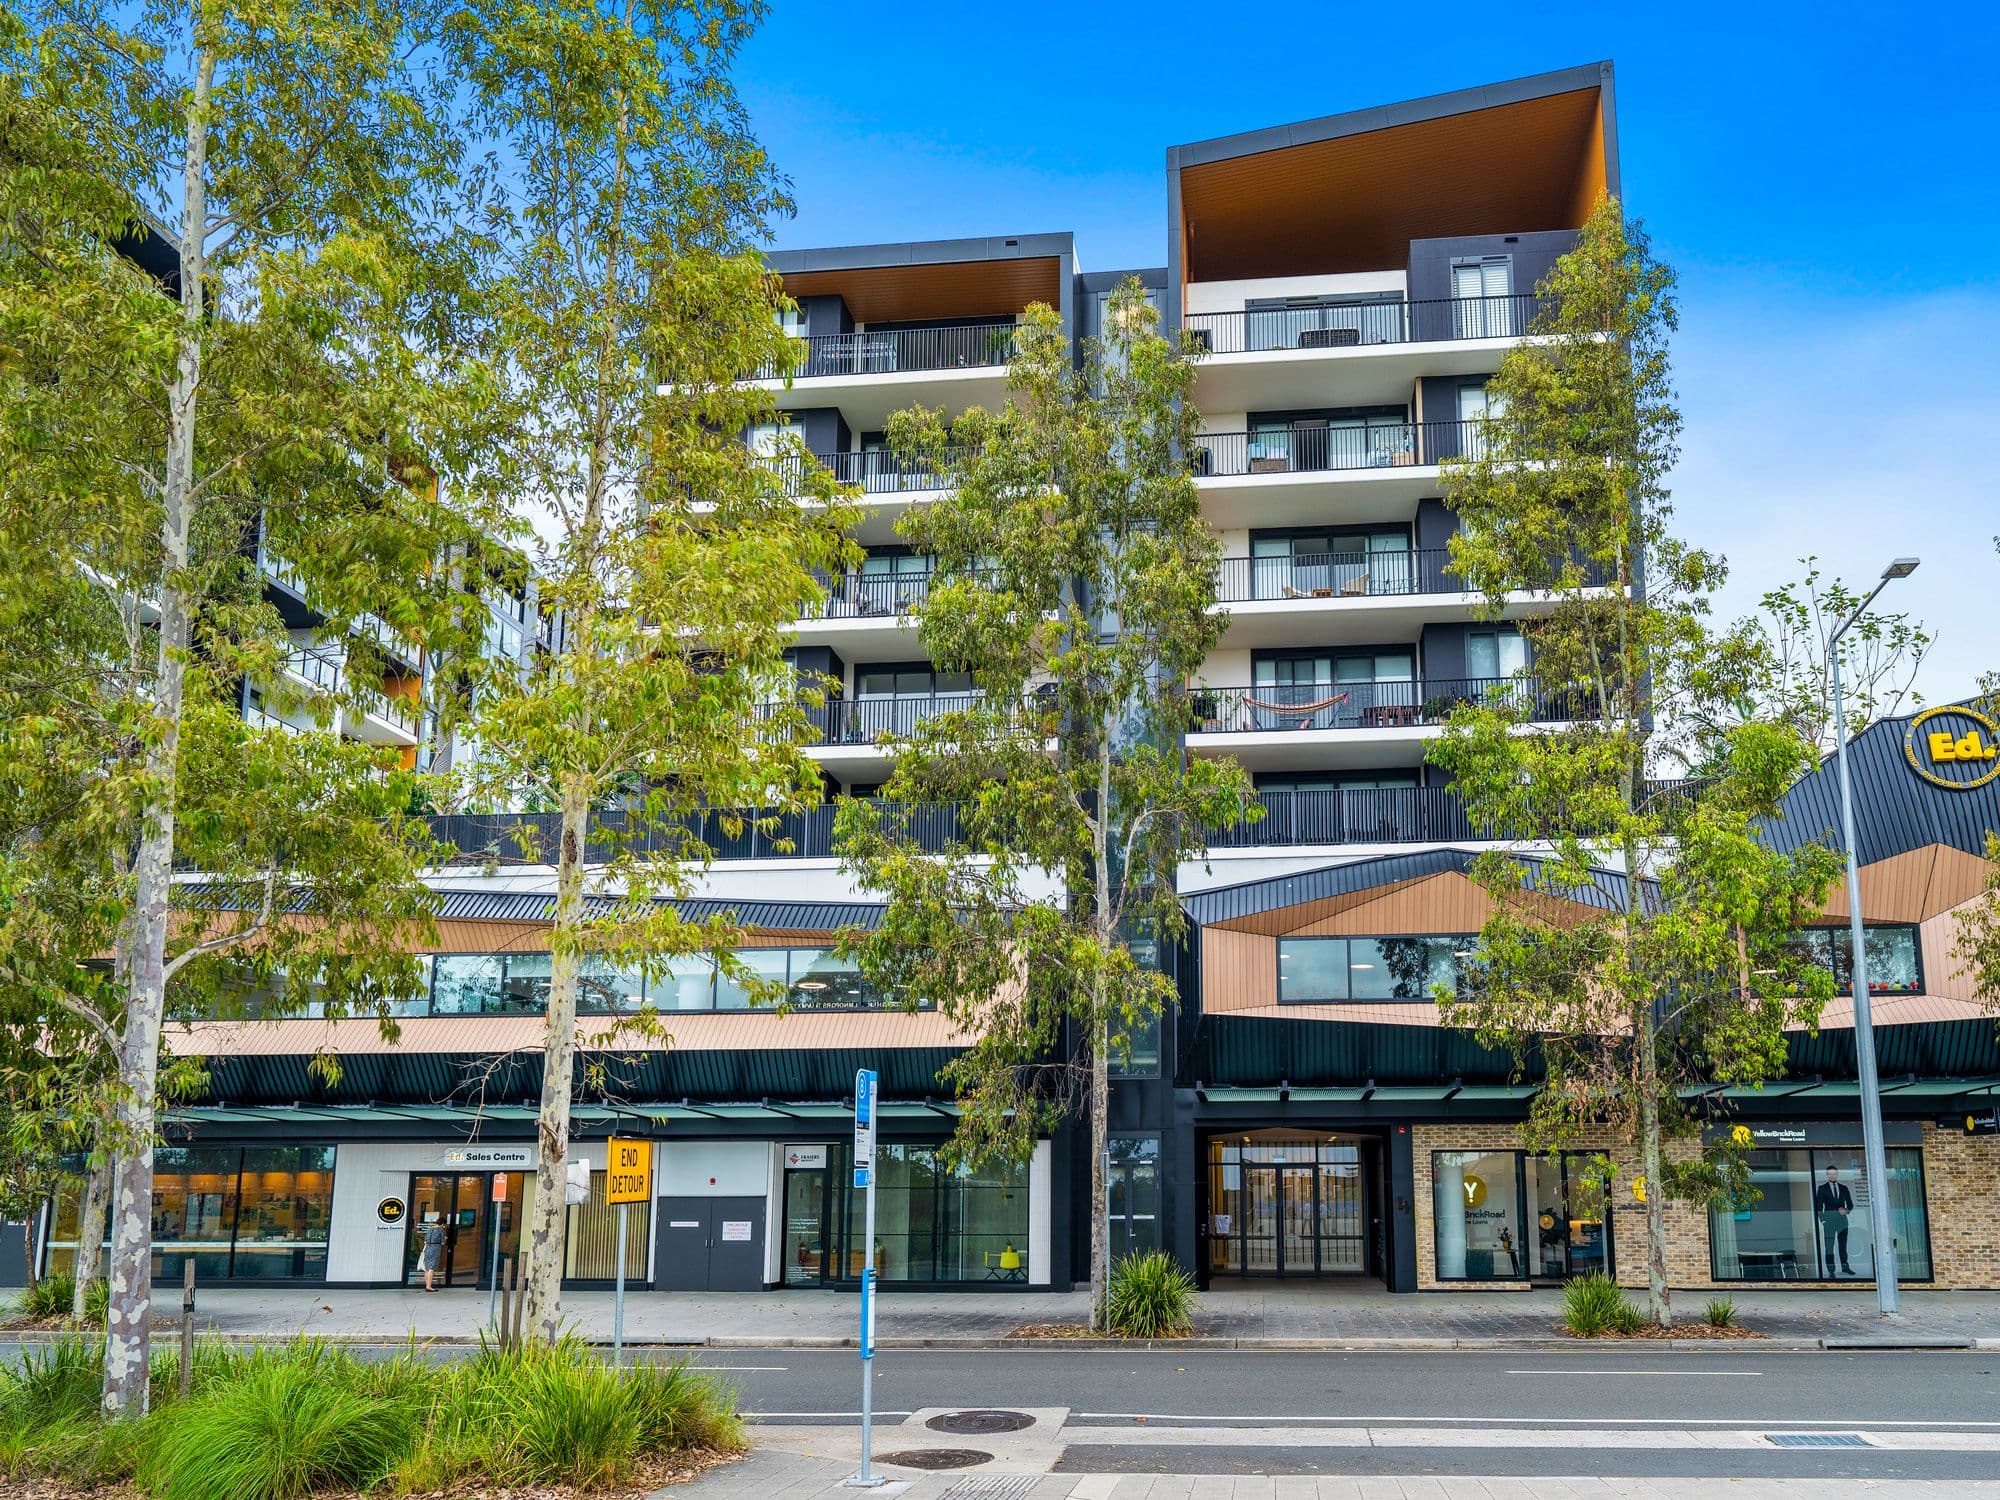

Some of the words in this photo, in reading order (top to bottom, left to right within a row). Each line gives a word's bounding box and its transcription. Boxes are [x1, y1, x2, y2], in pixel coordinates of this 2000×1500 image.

[1949, 706, 1972, 715] TOWN
[1929, 731, 1996, 762] Ed.
[1753, 1129, 1805, 1137] YellowBrickRoad
[466, 1152, 491, 1161] Sales
[493, 1152, 525, 1161] Centre
[621, 1148, 638, 1168] END
[612, 1175, 644, 1194] DETOUR
[384, 1206, 400, 1215] Ed.
[1465, 1209, 1505, 1218] BrickRoad
